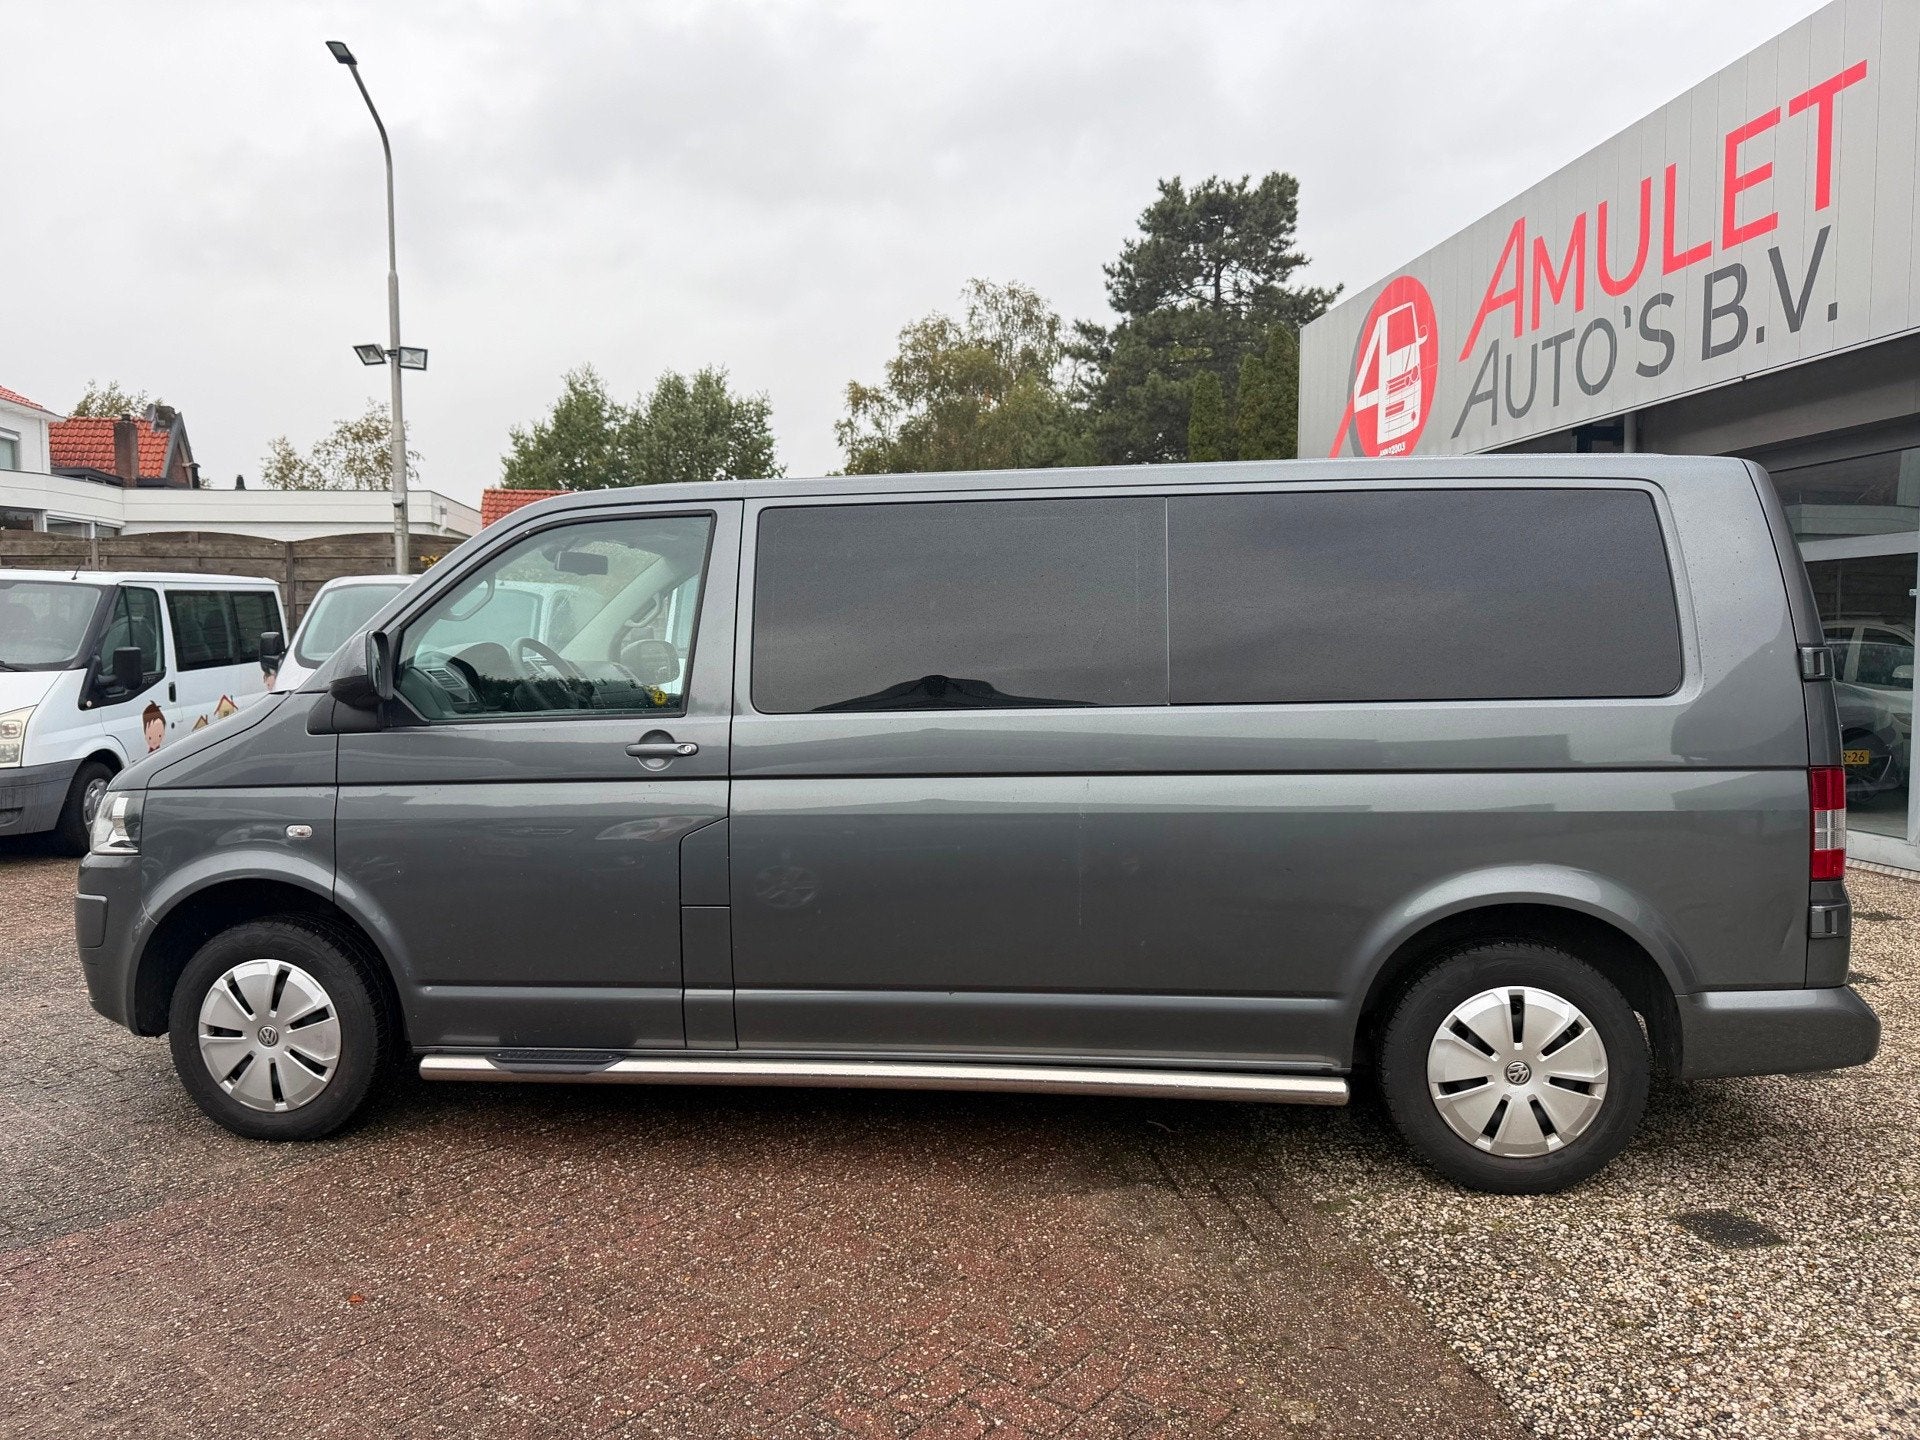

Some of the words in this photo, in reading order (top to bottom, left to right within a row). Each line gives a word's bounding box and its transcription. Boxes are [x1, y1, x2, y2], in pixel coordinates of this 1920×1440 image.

[1450, 292, 1675, 439] AUTO'S
[1701, 224, 1838, 361] B.V.
[1459, 59, 1867, 362] AMULET
